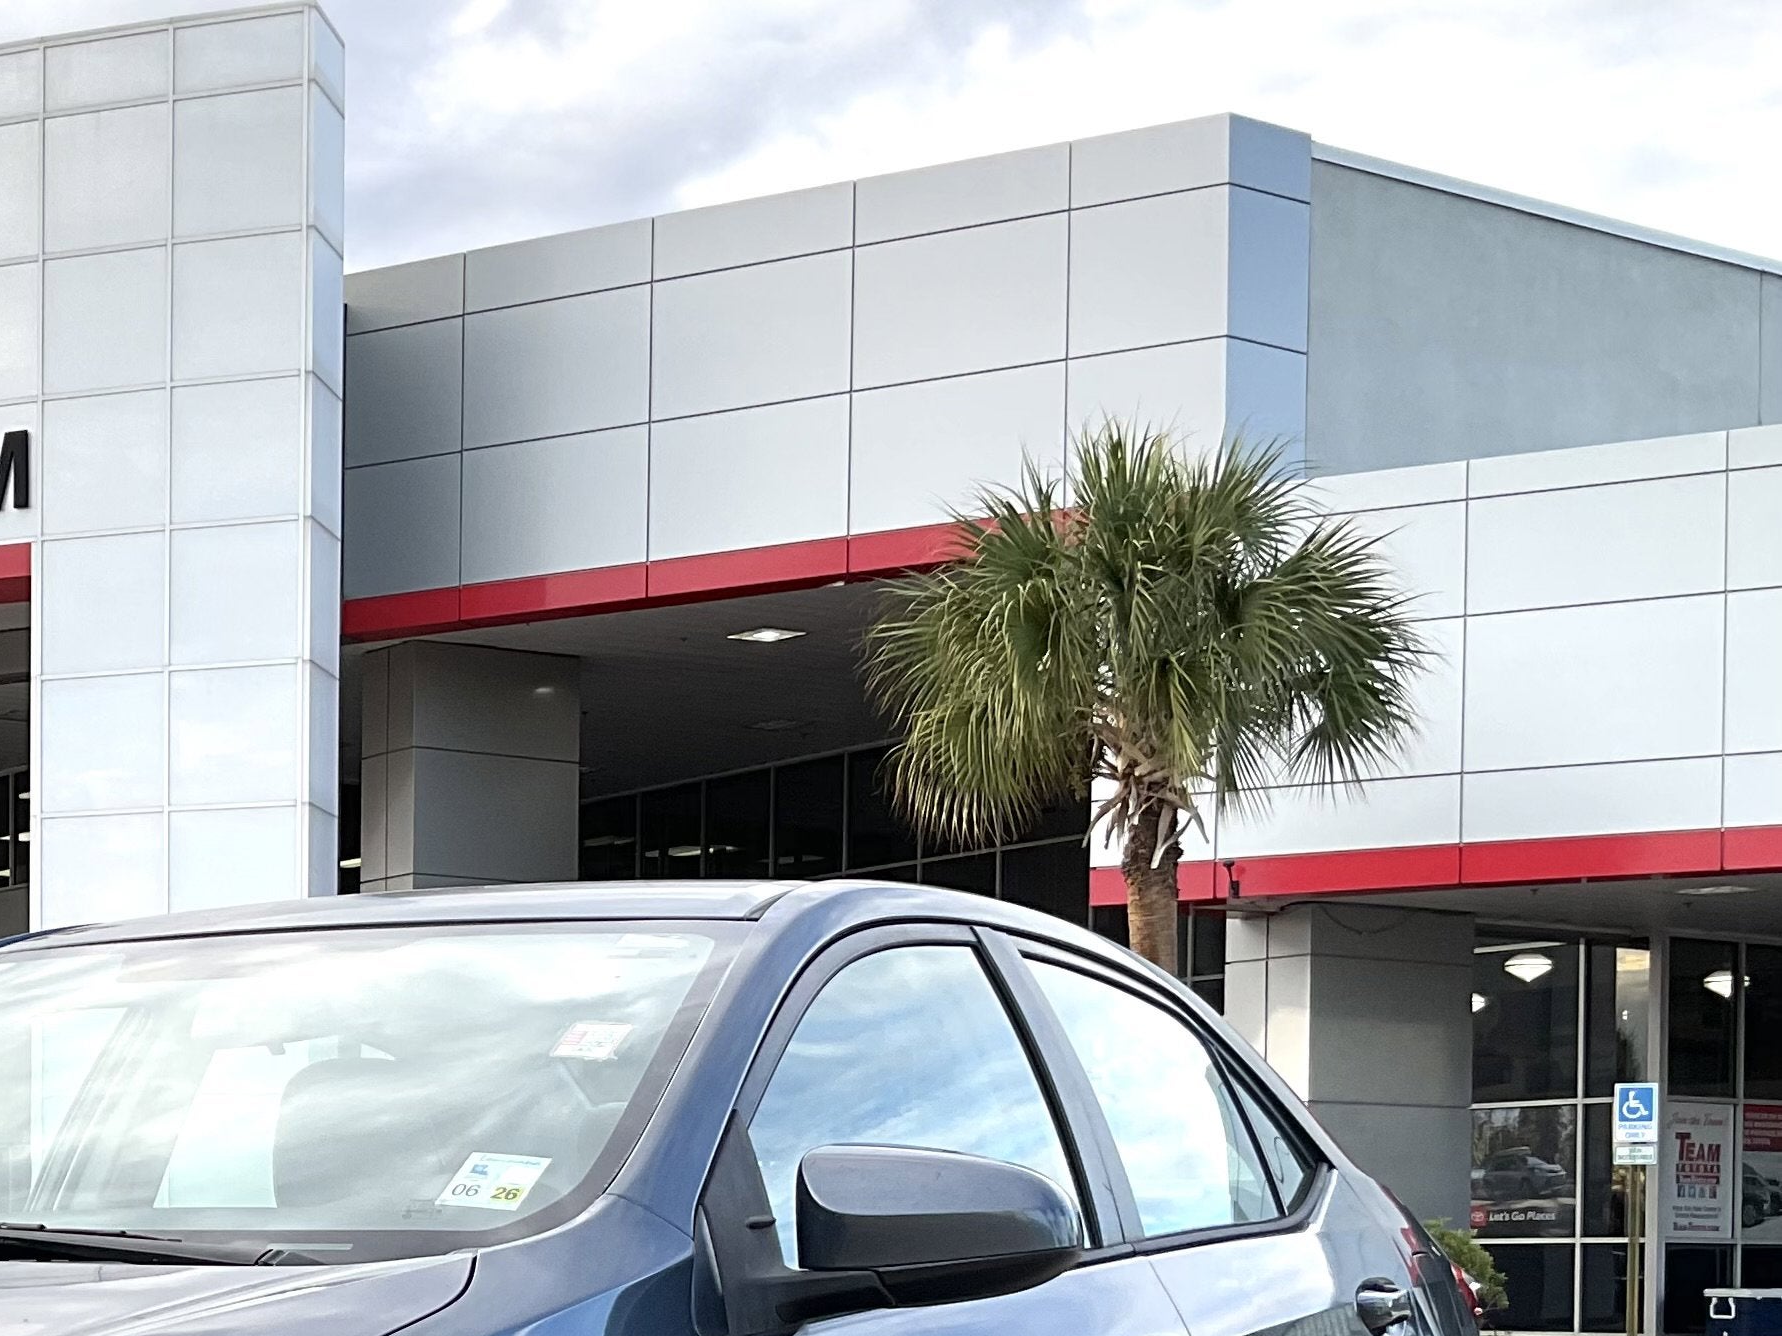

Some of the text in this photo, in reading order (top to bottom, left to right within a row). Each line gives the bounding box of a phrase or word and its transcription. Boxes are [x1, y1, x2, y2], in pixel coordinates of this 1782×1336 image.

[1675, 1132, 1721, 1162] TEAM
[451, 1183, 520, 1201] 06 26
[1488, 1210, 1556, 1221] Let's Go Places
